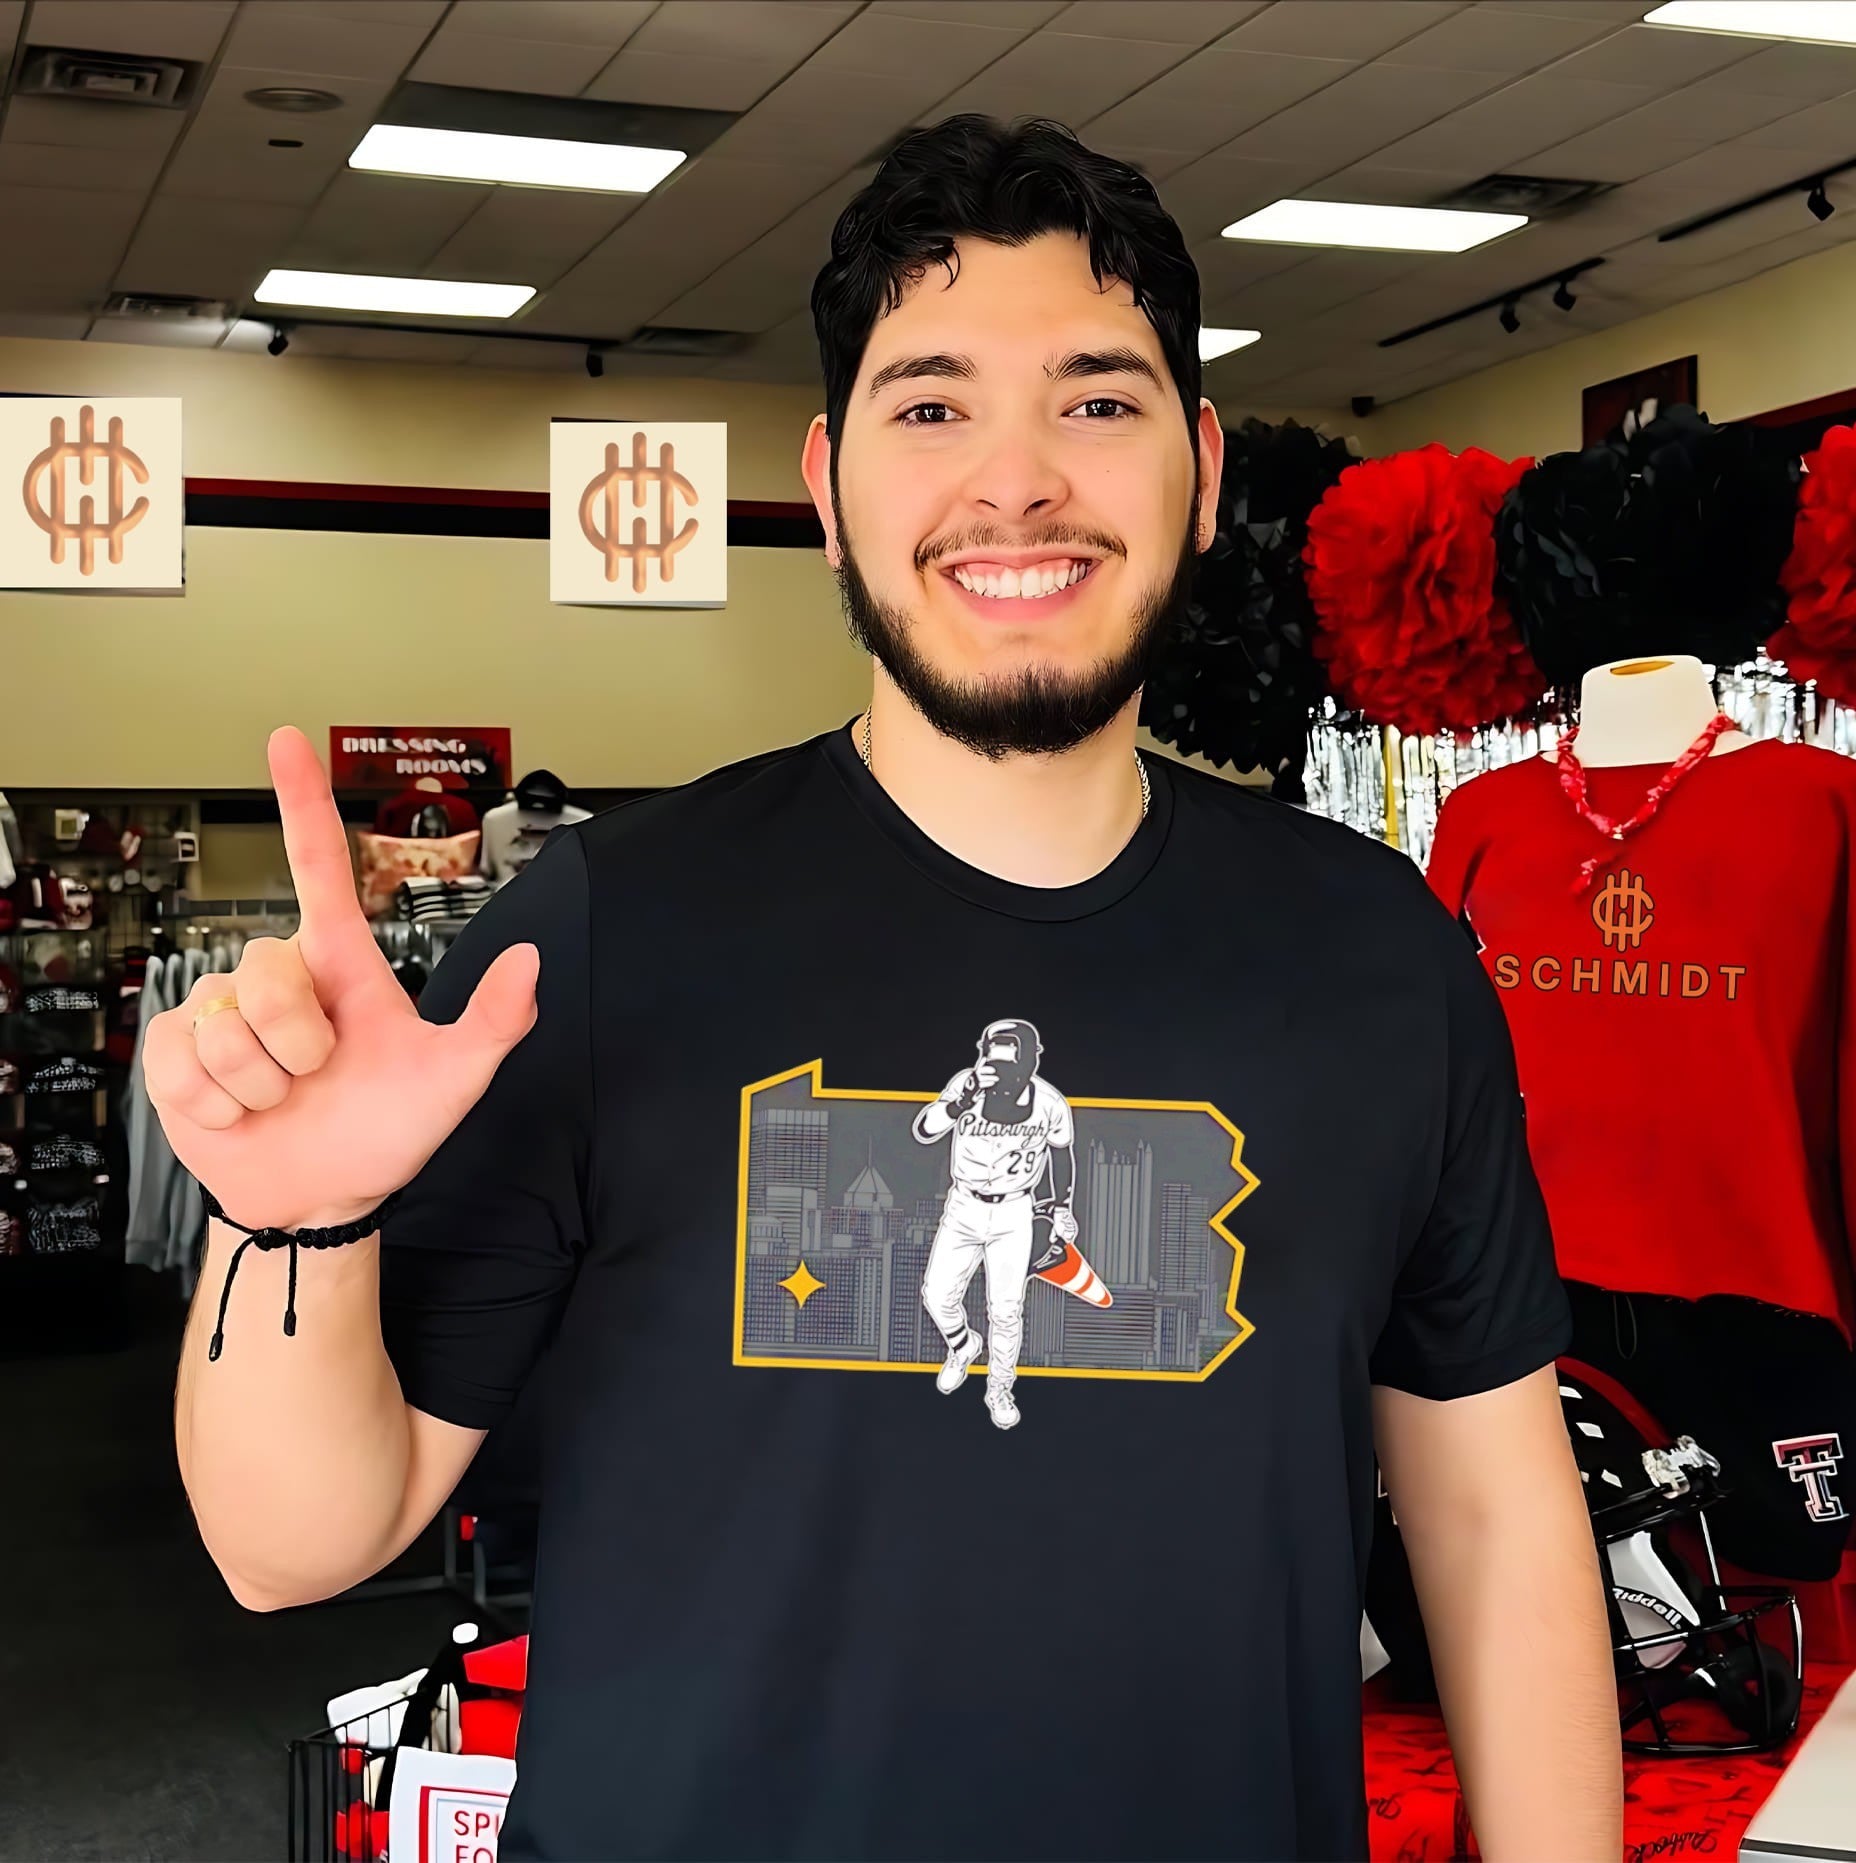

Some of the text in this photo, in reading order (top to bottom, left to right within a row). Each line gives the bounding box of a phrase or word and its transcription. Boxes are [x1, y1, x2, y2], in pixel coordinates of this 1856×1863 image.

[342, 737, 467, 754] DRESSING
[396, 758, 487, 775] ROOMS
[1494, 954, 1747, 1000] SCHMIDT
[958, 1112, 1047, 1149] Pittsburgh
[1007, 1151, 1037, 1175] 29
